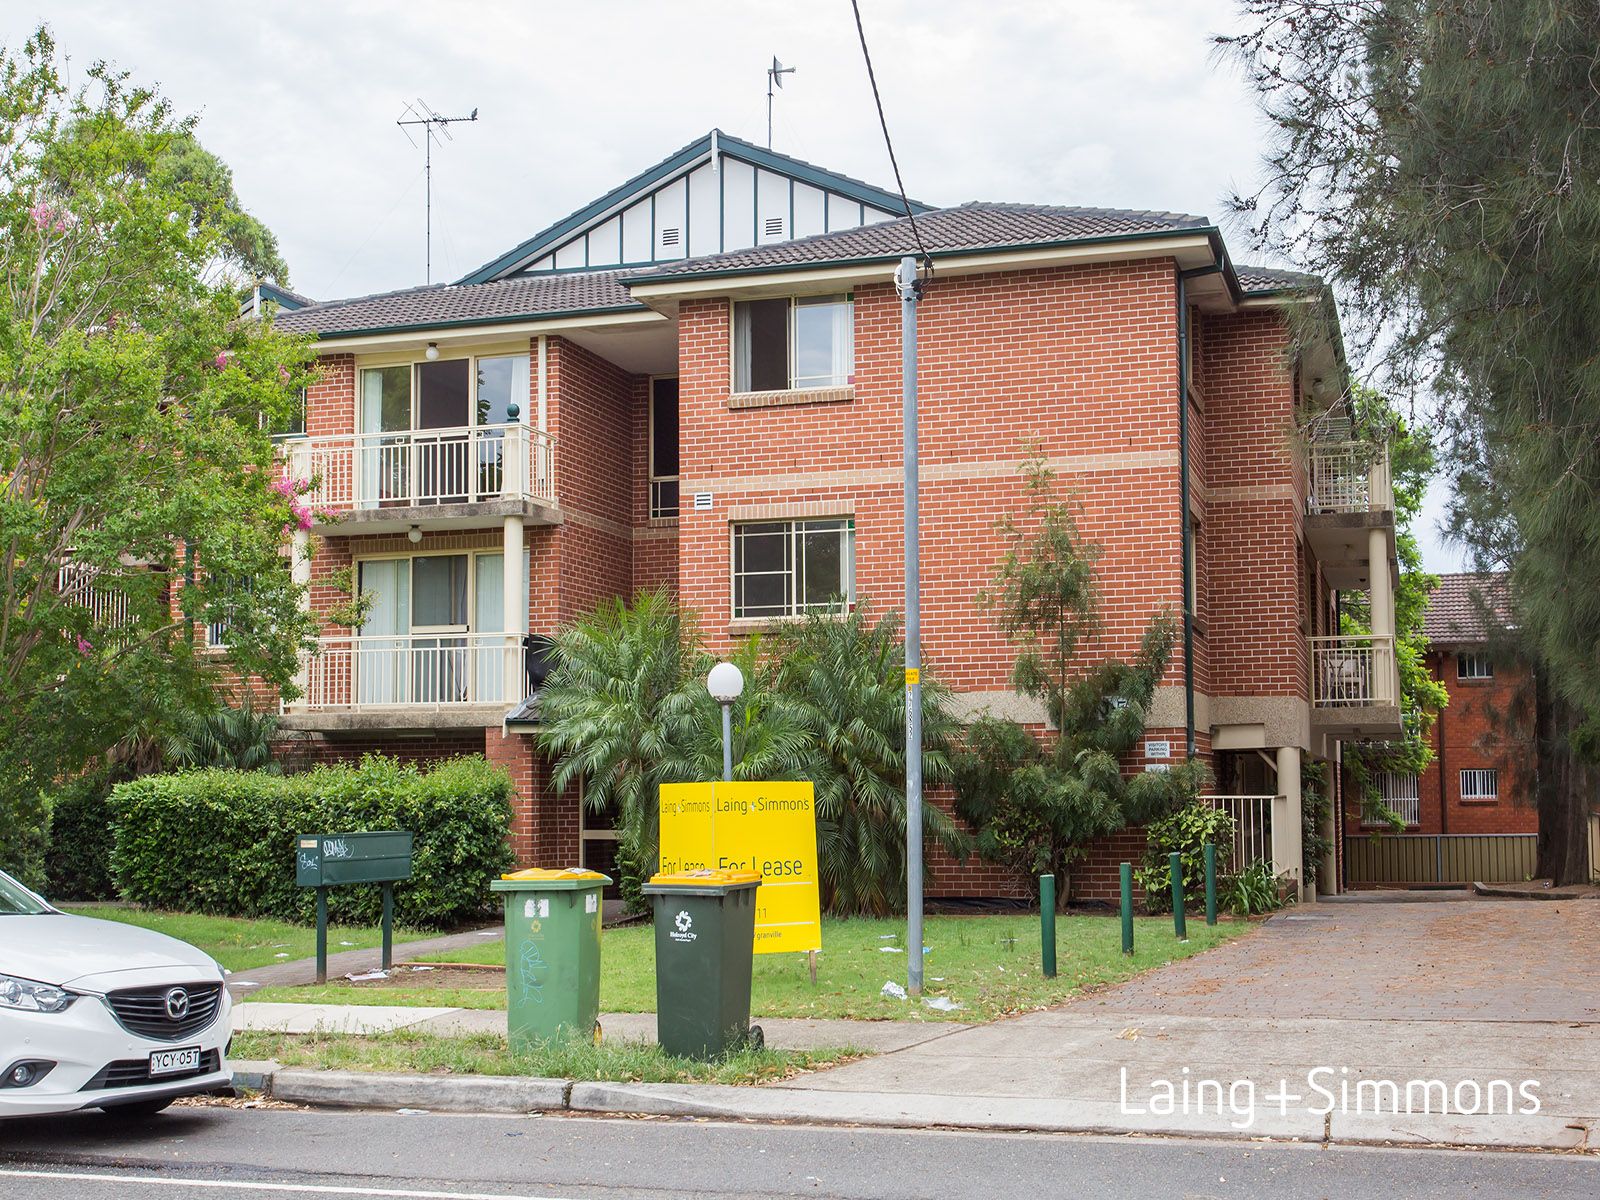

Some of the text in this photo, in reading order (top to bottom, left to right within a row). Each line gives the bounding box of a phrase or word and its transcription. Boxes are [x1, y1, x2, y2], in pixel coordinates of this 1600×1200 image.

[662, 857, 677, 875] For
[719, 856, 803, 876] For Lease
[687, 932, 698, 941] City
